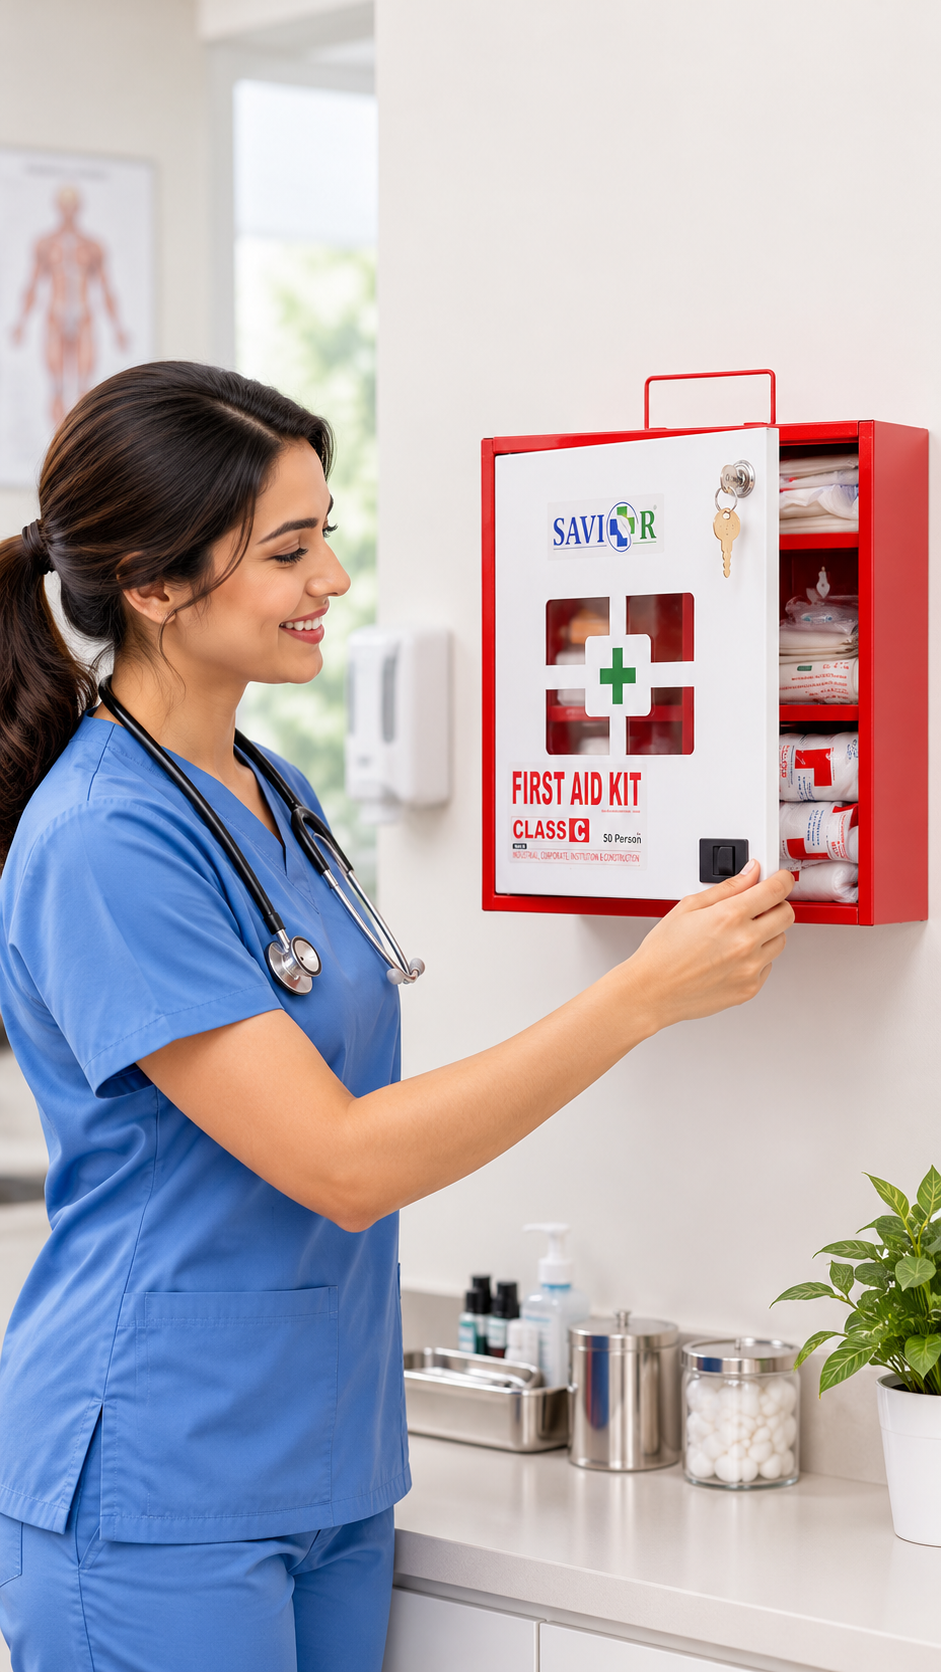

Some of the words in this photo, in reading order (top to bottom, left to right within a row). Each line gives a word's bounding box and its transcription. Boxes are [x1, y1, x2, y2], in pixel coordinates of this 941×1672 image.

[553, 502, 657, 551] SAVIOR
[512, 771, 565, 805] FIRST
[570, 772, 602, 805] AID
[609, 772, 641, 806] KIT
[513, 819, 566, 839] CLASS
[573, 819, 587, 842] C
[603, 833, 612, 843] 50
[614, 834, 642, 844] Person
